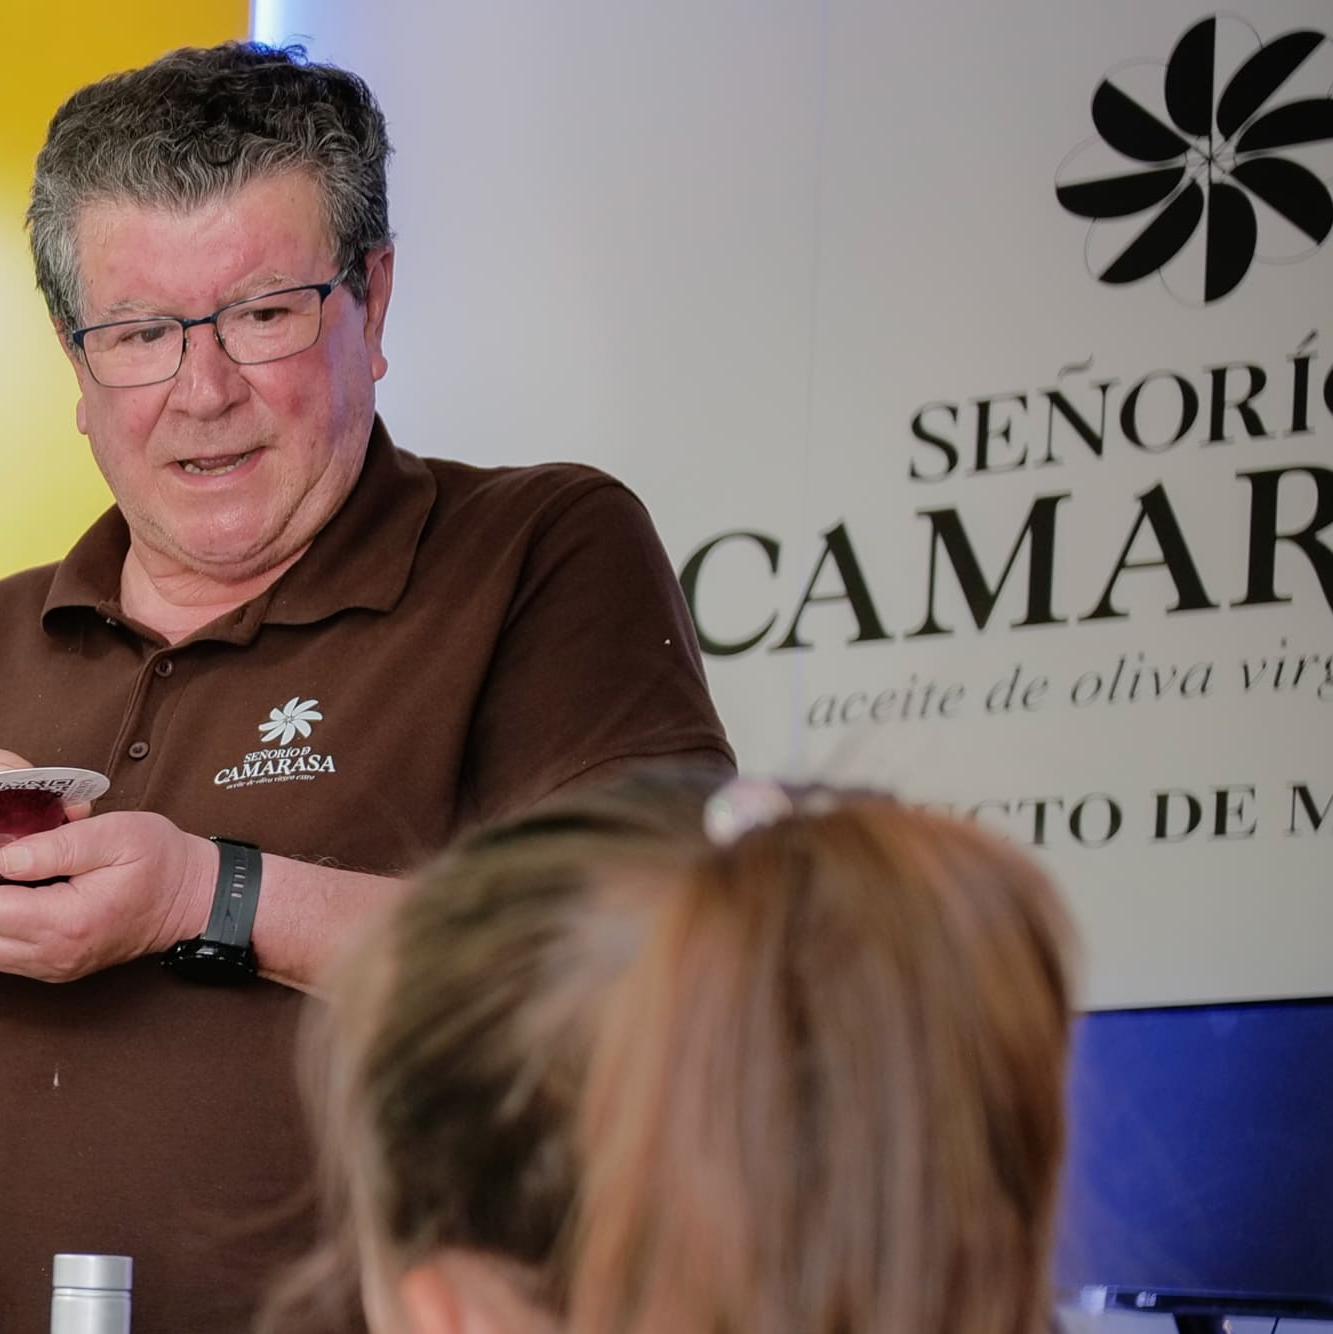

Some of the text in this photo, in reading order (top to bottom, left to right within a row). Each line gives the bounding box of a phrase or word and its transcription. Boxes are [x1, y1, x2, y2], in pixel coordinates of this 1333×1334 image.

[908, 330, 1333, 484] SEÑORÍ
[806, 672, 966, 729] aceite
[984, 663, 1050, 715] de
[1069, 652, 1215, 709] oliva
[214, 754, 336, 785] CAMARASA
[1151, 784, 1257, 844] DE
